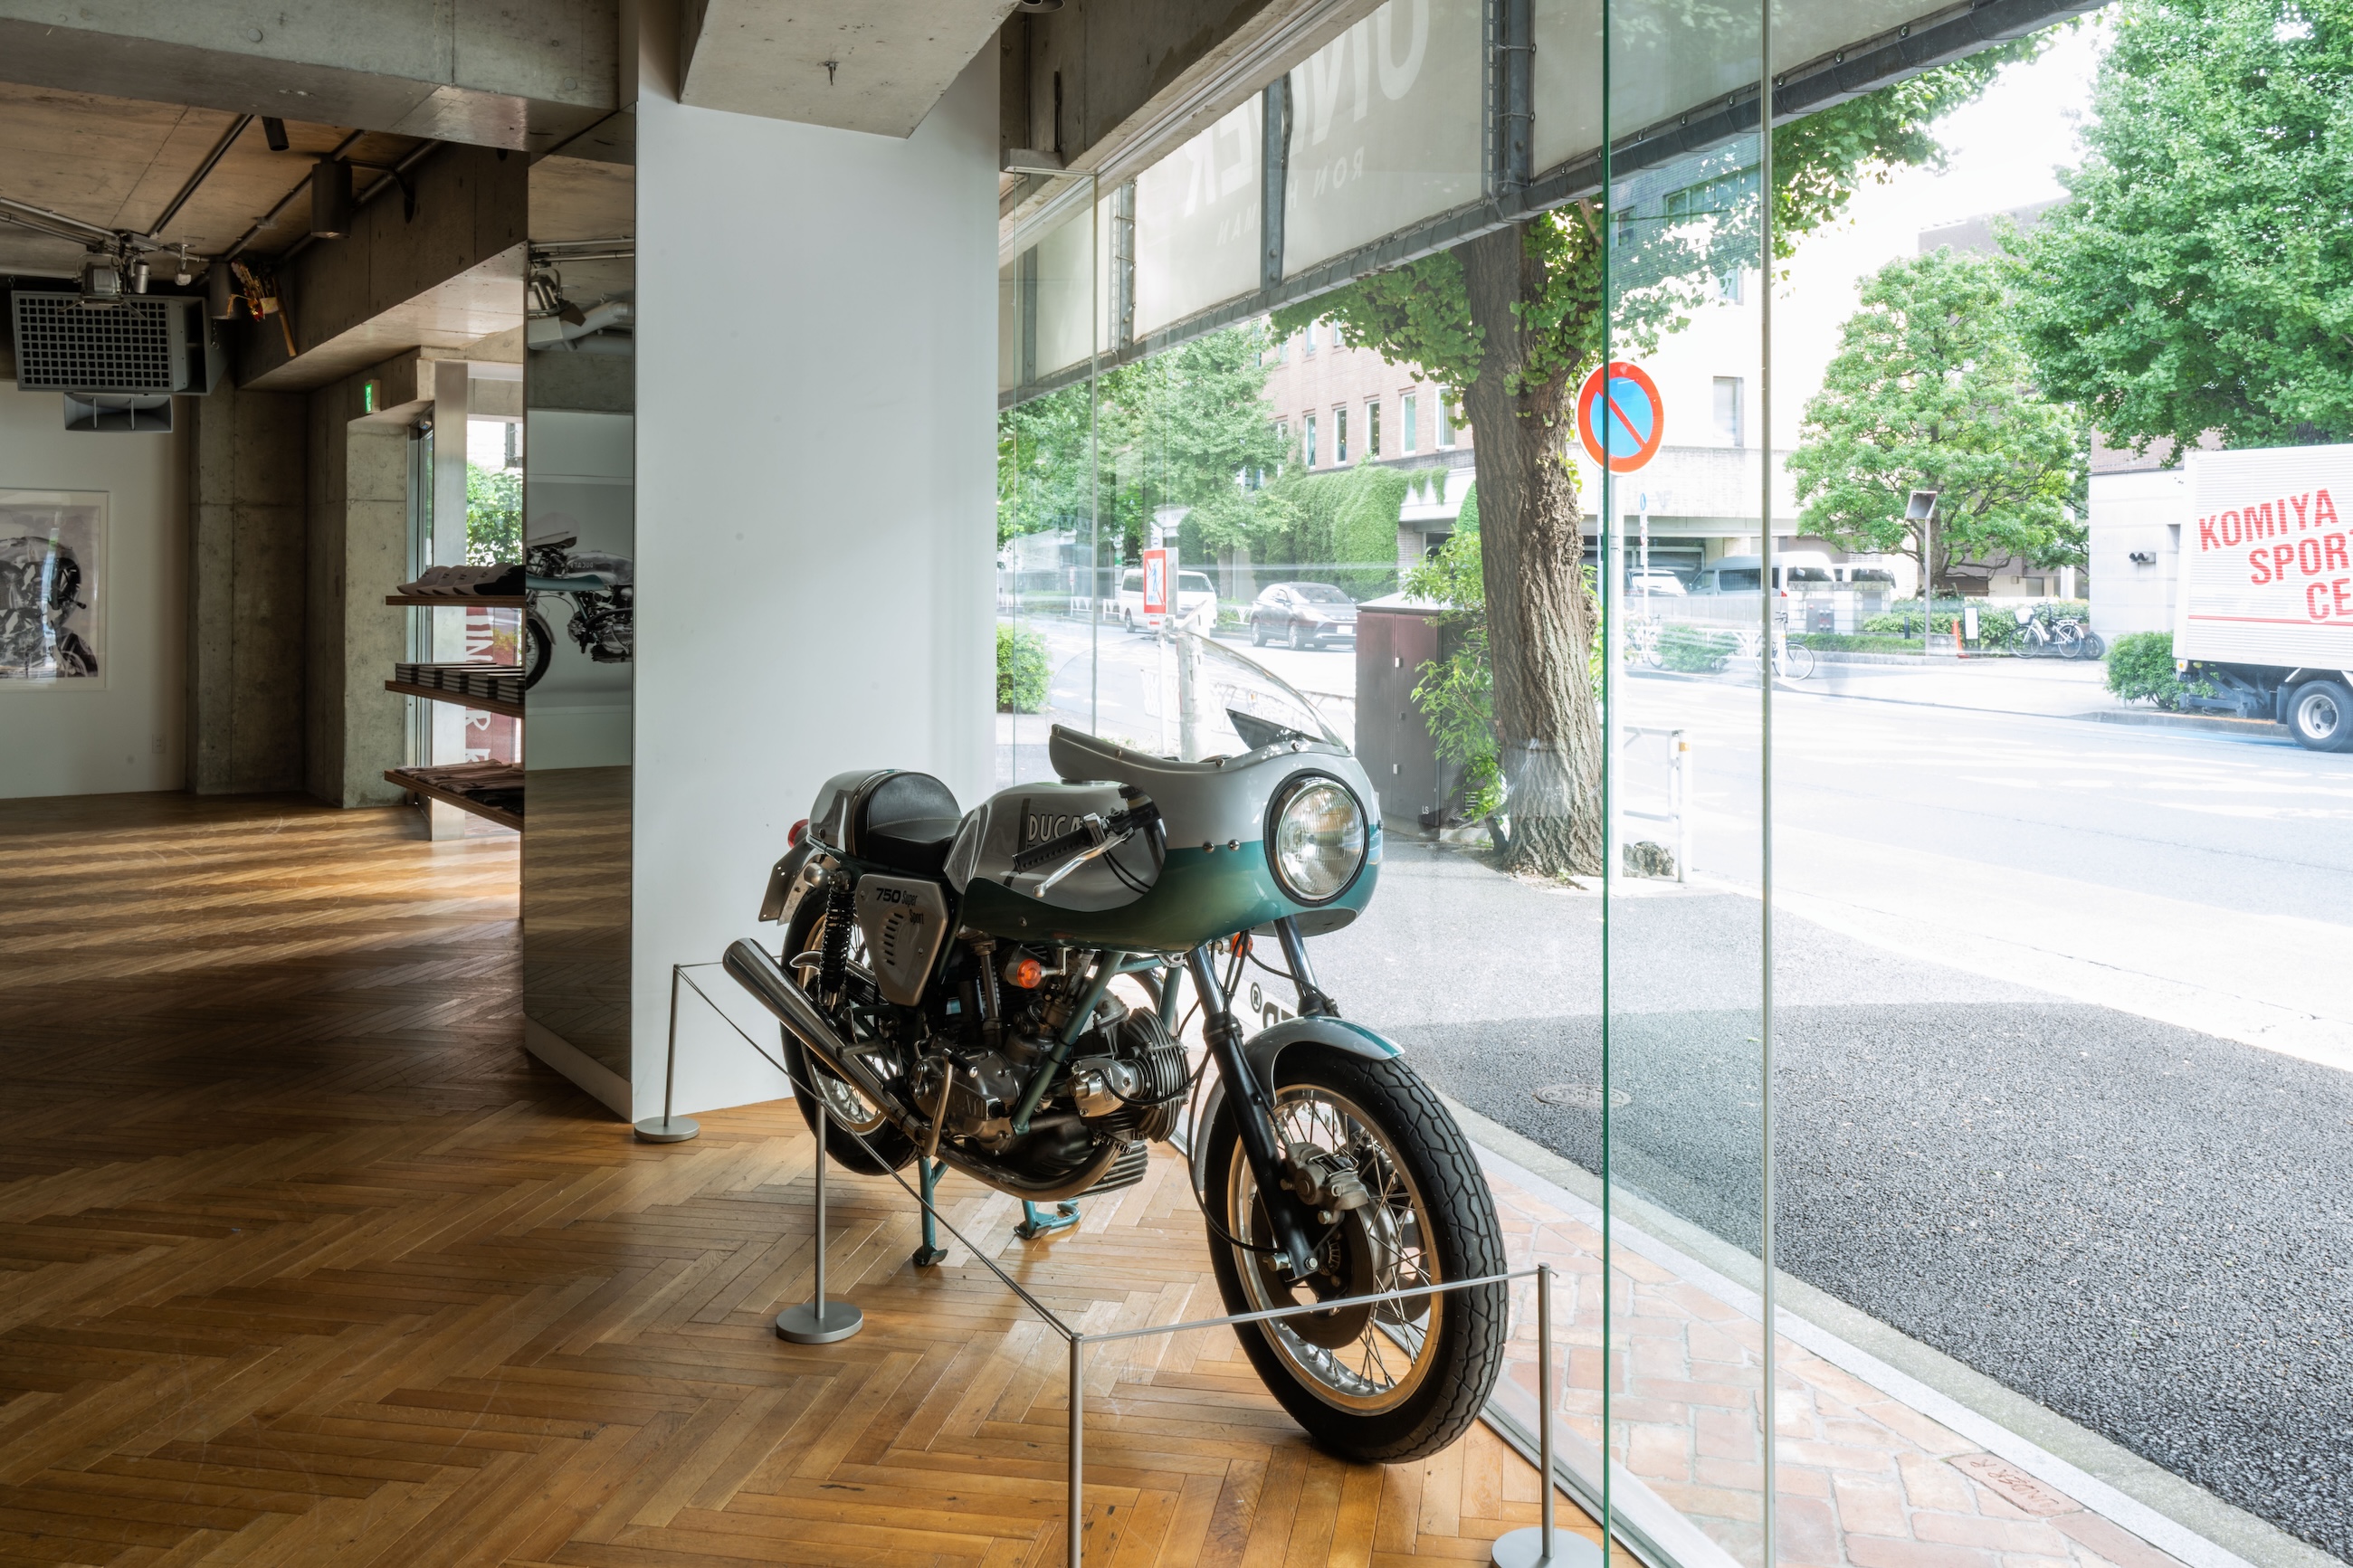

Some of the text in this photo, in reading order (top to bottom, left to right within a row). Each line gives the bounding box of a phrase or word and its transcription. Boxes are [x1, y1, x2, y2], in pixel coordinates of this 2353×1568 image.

[2198, 488, 2339, 553] KOMIYA
[2248, 528, 2353, 586] SPOR
[1027, 813, 1081, 843] DUCA
[876, 887, 919, 908] 750 Super
[909, 908, 925, 926] Sport
